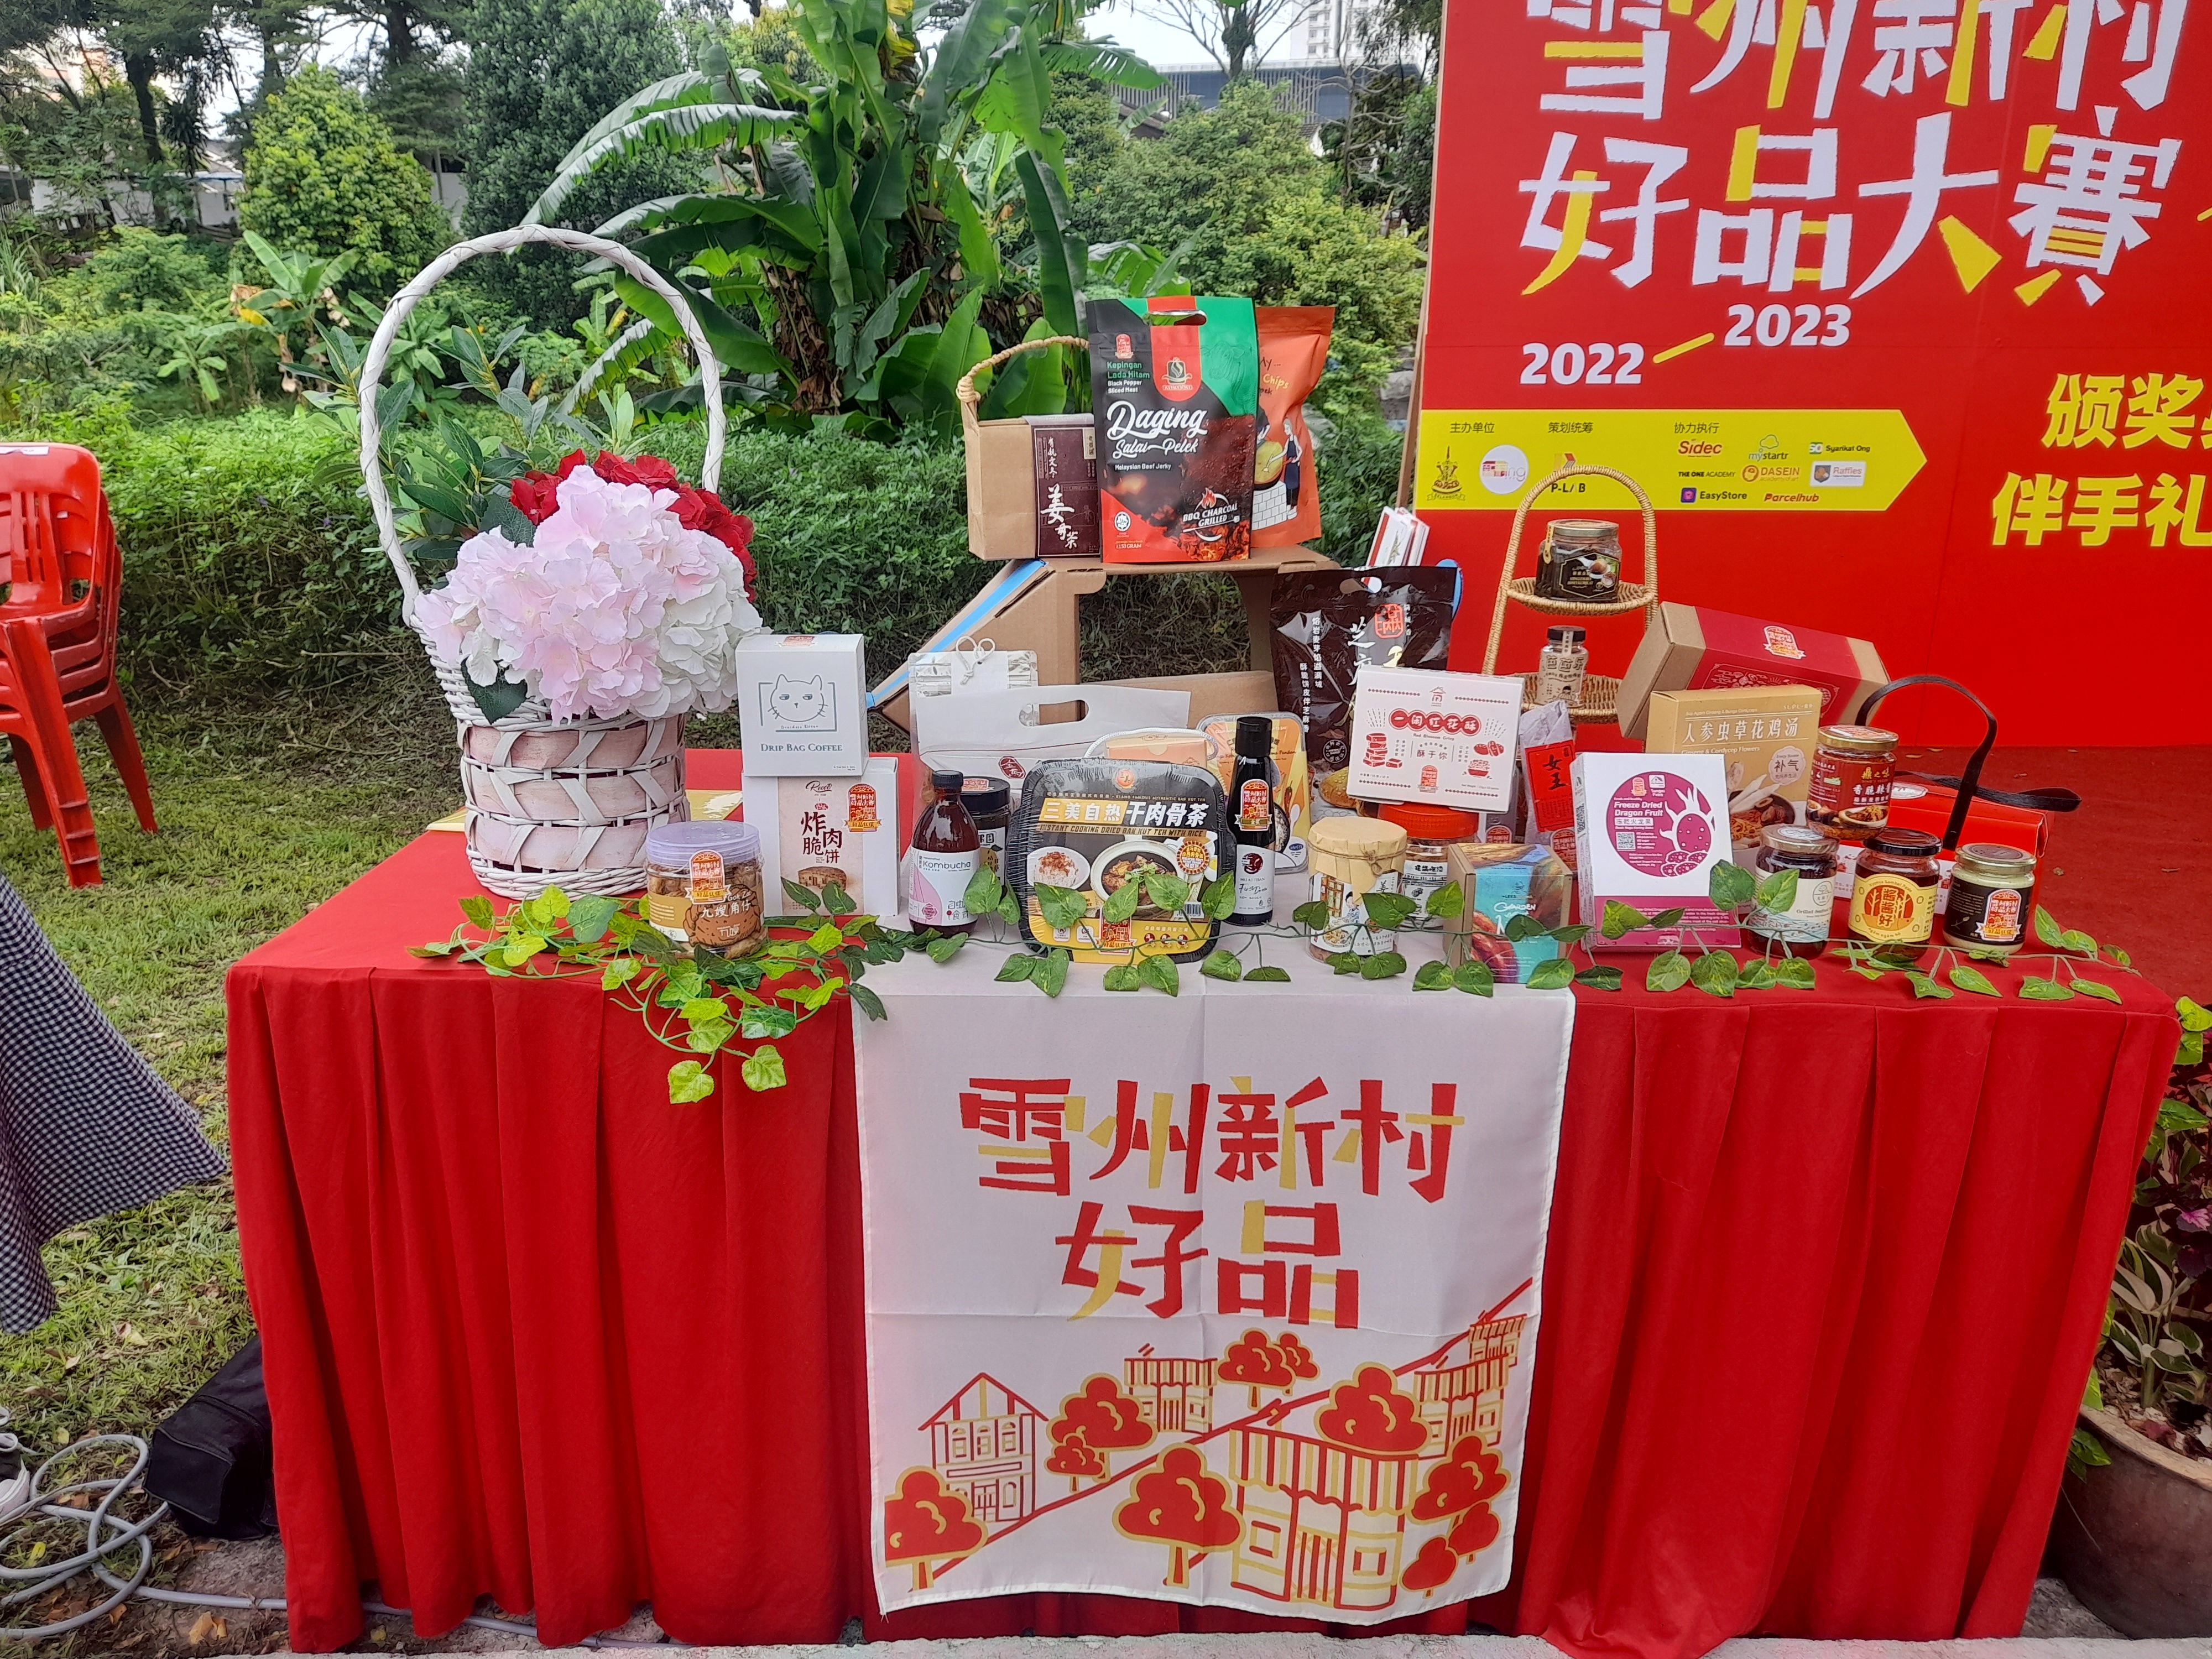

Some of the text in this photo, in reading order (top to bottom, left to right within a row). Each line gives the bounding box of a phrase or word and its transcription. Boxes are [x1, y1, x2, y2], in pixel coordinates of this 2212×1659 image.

[1527, 0, 2188, 118] 雪州新村
[1518, 105, 2183, 306] 好品大賽
[1724, 304, 1851, 347] 2023
[1107, 361, 1142, 369] Kepingan
[1519, 342, 1644, 385] 2022
[1108, 371, 1150, 379] Lada Hitam
[1262, 373, 1290, 390] Chips
[2041, 372, 2212, 449] 颁奖
[1107, 400, 1208, 440] Daging
[1449, 422, 1495, 434] 主办单位
[1548, 422, 1594, 434] 策划统筹
[1674, 422, 1720, 434] 协力执行
[1161, 437, 1199, 456] Pelek
[1678, 439, 1723, 456] Sidec
[1856, 445, 1871, 453] Ong
[1748, 451, 1789, 461] mystartr
[1761, 467, 1800, 476] DASEIN
[1699, 491, 1747, 501] EasyStore
[1764, 493, 1819, 502] Parcelhub
[1182, 503, 1238, 523] BBQ CHARCOAL
[1992, 471, 2212, 547] 伴手礼
[1198, 514, 1228, 527] GRILLED
[1682, 717, 1799, 744] 人参虫草花鸡汤
[760, 743, 843, 752] DRIP BAG COFFEE
[1416, 749, 1448, 760] 酥于你
[1773, 759, 1799, 773] 补气
[1614, 809, 1643, 817] Dragon
[922, 860, 971, 869] Kombucha
[700, 899, 752, 919] 九嫂角仔
[1494, 902, 1536, 912] GARDEN
[959, 1076, 1465, 1204] 雪州新村
[1055, 1199, 1359, 1329] 好品
